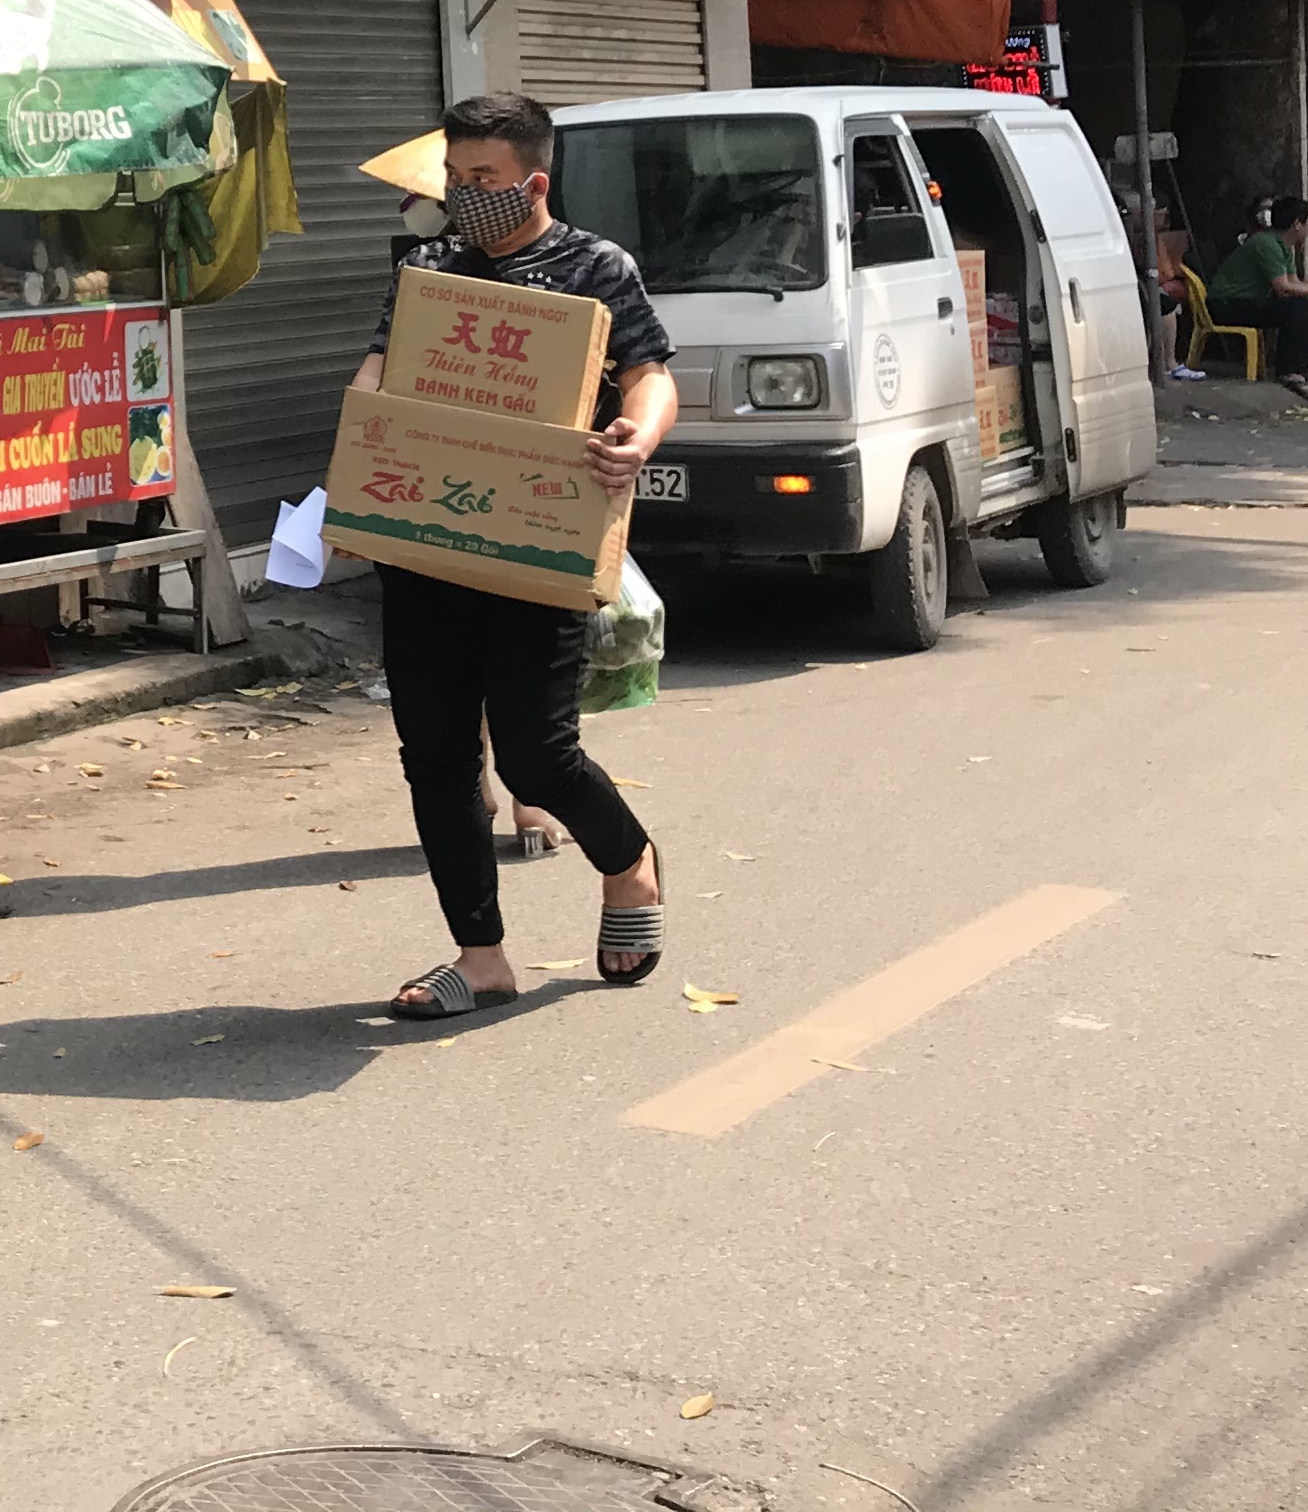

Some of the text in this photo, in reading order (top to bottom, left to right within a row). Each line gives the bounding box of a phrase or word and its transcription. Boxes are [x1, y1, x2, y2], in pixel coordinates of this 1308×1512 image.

[20, 106, 132, 148] TUBORG
[6, 326, 46, 355] Mai
[51, 323, 87, 351] Tài
[442, 311, 532, 363] 天虹
[2, 374, 22, 416] GIA
[69, 361, 101, 408] ƯỚC
[104, 351, 122, 403] LỄ
[464, 386, 499, 406] KEM
[8, 420, 55, 472] CUỐN
[57, 421, 79, 463] LÁ
[81, 423, 123, 460] SUNG
[25, 477, 62, 508] BUÔN
[68, 473, 96, 501] BÁN
[98, 463, 114, 497] LẺ
